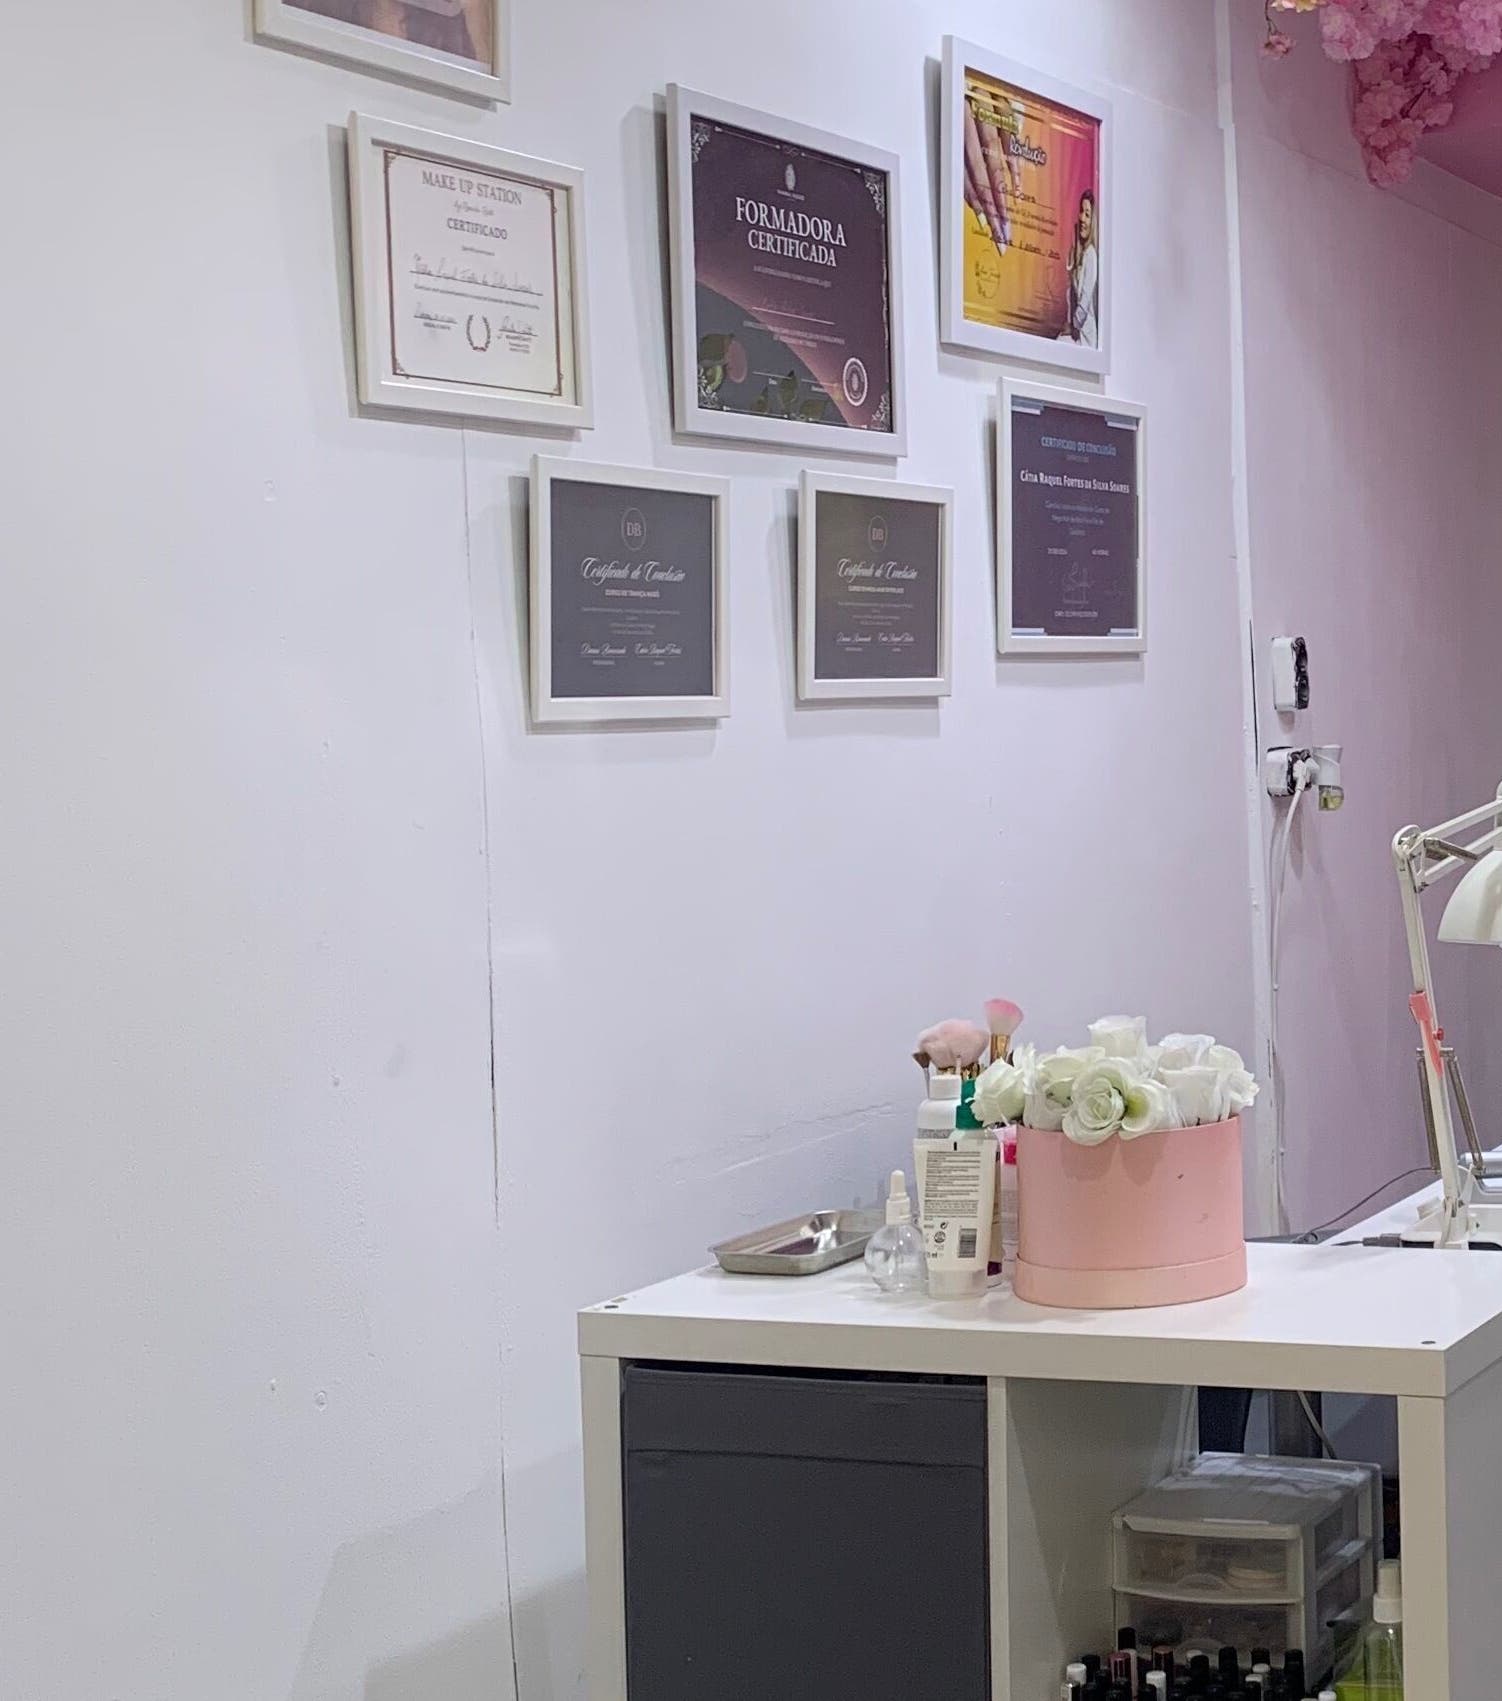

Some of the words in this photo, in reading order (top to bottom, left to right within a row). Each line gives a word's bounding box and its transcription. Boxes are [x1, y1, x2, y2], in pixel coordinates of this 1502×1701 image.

[421, 170, 456, 191] MAKE
[458, 178, 474, 195] UP
[476, 183, 522, 205] STATION
[447, 217, 508, 240] CERTIFICADO
[735, 196, 848, 247] FORMADORA
[748, 229, 837, 267] CERTIFICADA
